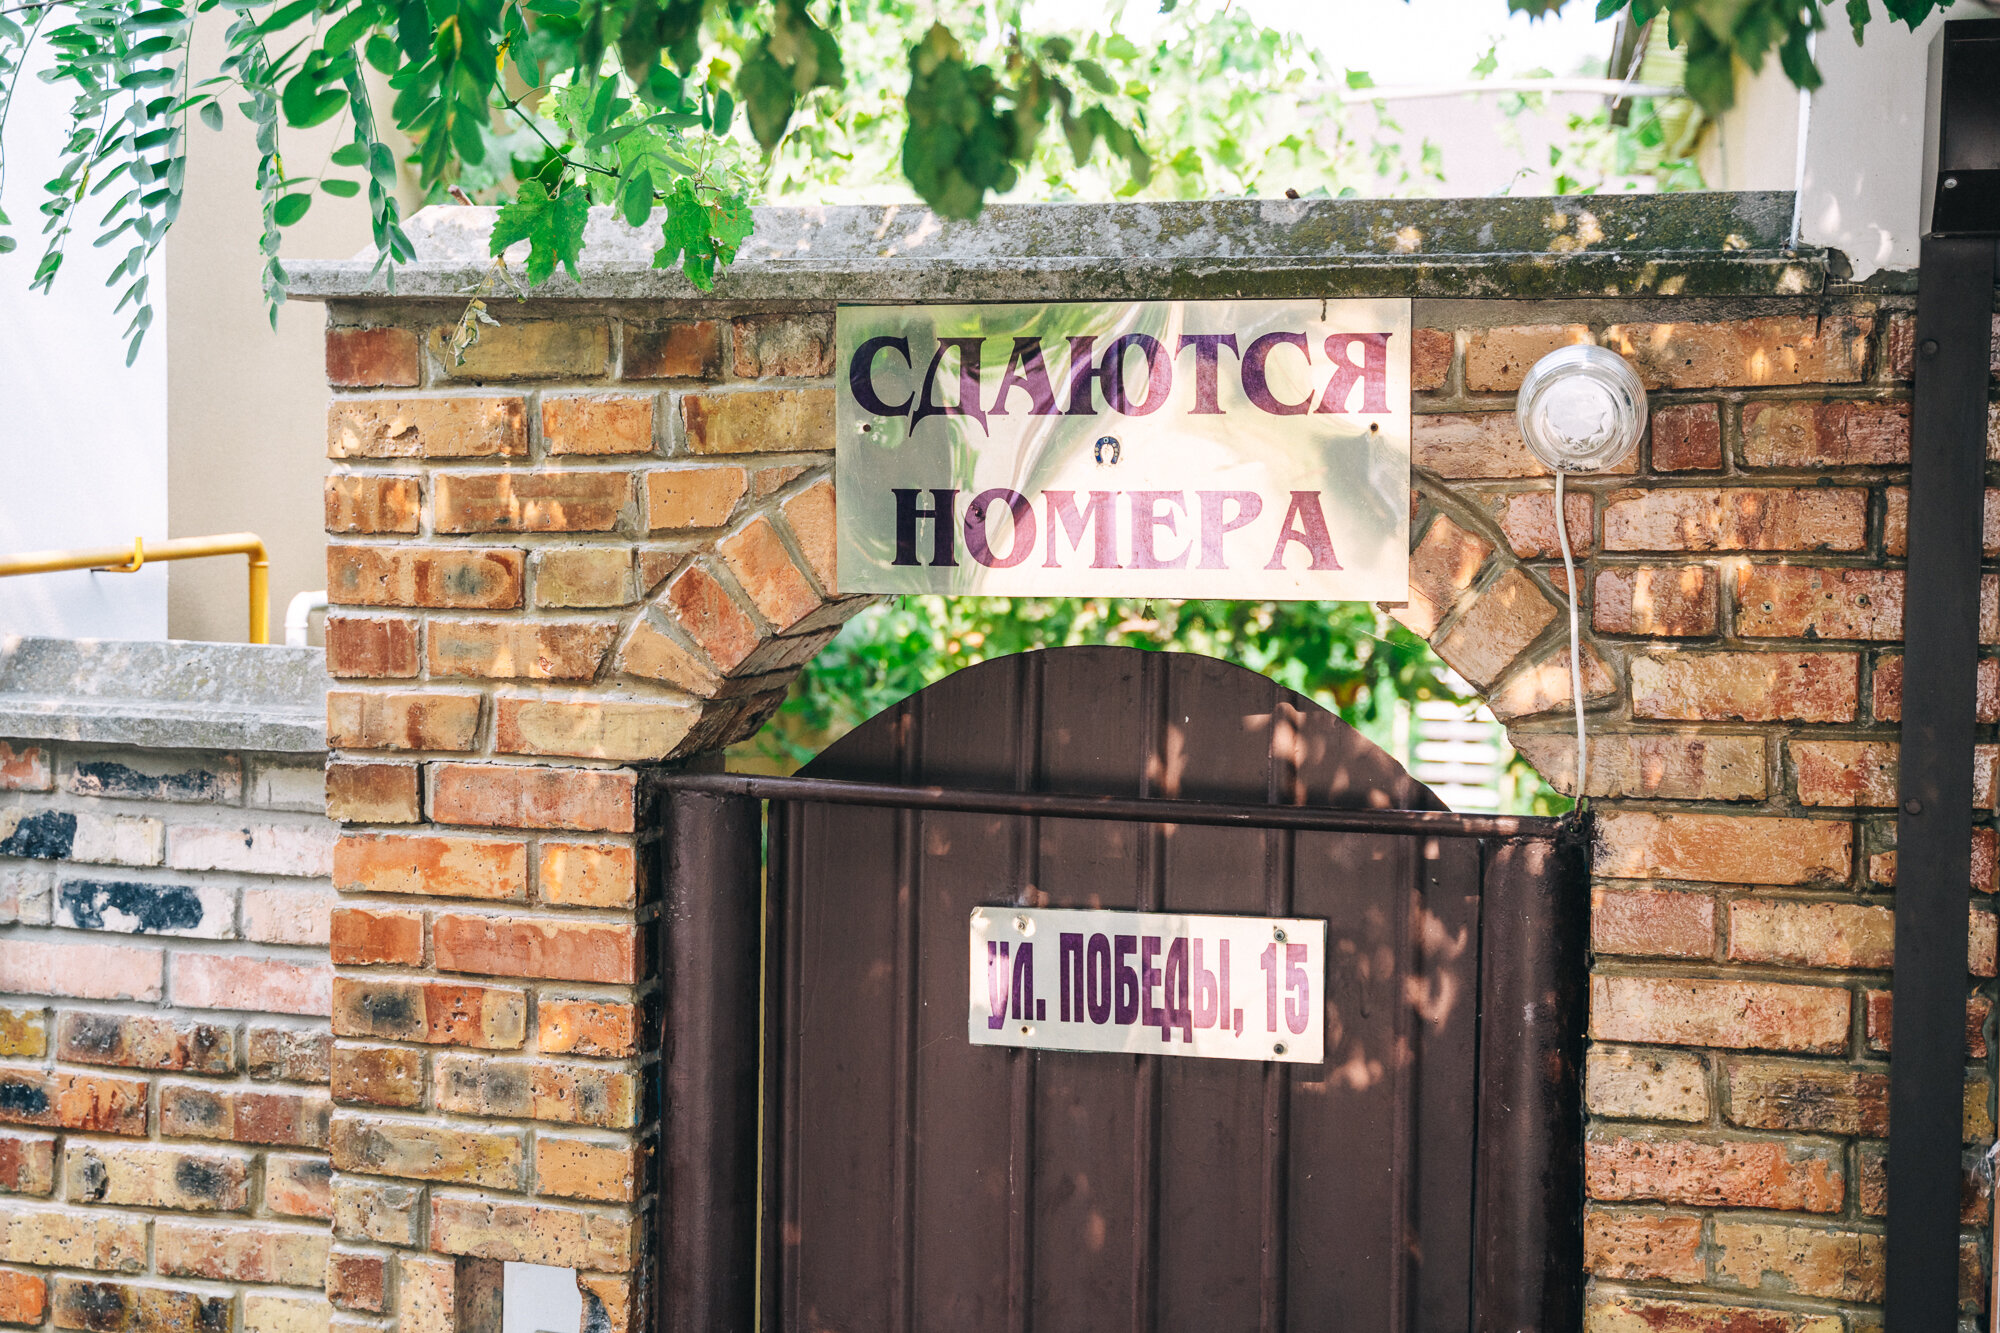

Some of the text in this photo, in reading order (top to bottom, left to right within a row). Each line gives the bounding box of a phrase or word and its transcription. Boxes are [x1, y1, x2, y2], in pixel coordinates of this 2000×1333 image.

[849, 331, 1393, 437] СДАЮТСЯ
[891, 488, 1344, 570] НОМЕРА
[1059, 932, 1243, 1043] ПОБЕДЫ,
[1260, 942, 1310, 1035] 15
